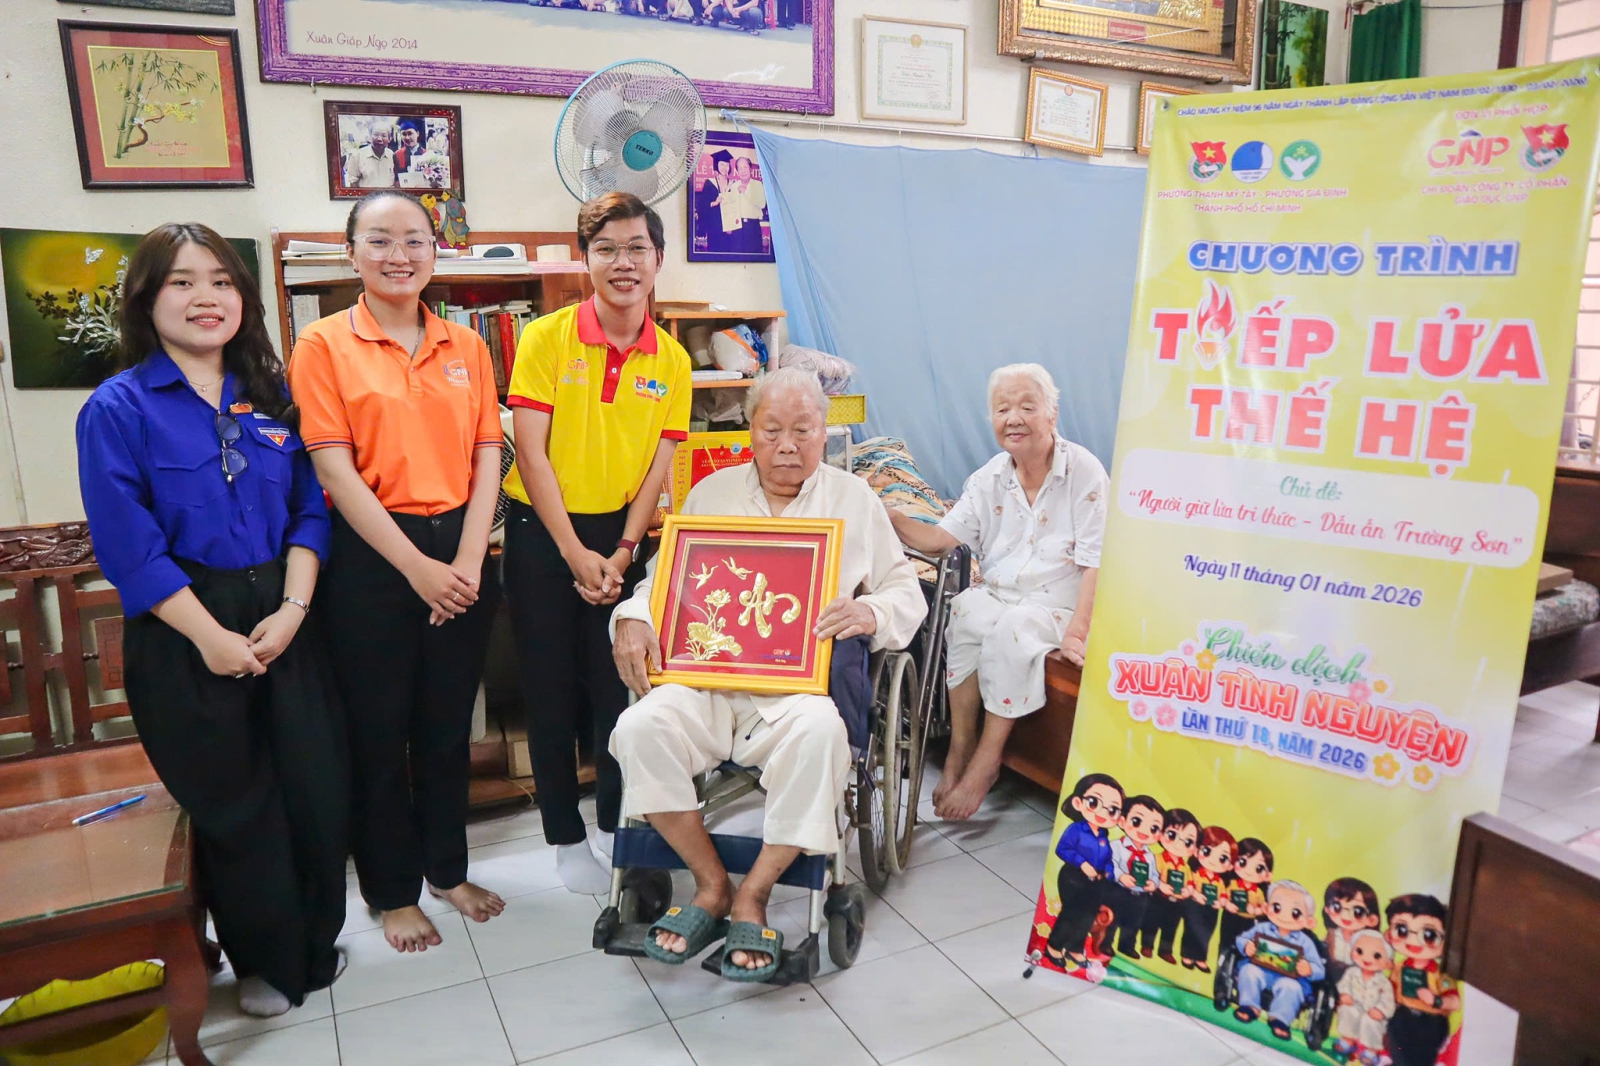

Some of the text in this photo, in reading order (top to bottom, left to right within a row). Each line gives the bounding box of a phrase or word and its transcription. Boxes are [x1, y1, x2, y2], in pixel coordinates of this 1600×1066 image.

[306, 30, 418, 51] Xuân Giáp Ngọ 2014
[1177, 106, 1196, 116] CHÀO
[1198, 105, 1220, 115] MỪNG
[1233, 102, 1252, 113] NIỆM
[1264, 102, 1281, 111] NĂM
[1419, 89, 1436, 100] VIỆT
[1439, 89, 1459, 98] NAM
[1428, 136, 1511, 169] GNP
[1157, 188, 1193, 199] PHƯỜNG
[1242, 188, 1258, 198] TÂY
[1265, 188, 1304, 198] PHƯỜNG
[1324, 188, 1348, 198] ĐỊNH
[1194, 201, 1301, 213] THÀNH PHỐ HỒ CHÍ MINH
[1187, 236, 1517, 274] CHƯƠNG TRÌNH
[1368, 306, 1542, 381] LỬA
[1189, 380, 1470, 476] THẾ HỆ
[1280, 475, 1342, 501] Chủ đề:
[1184, 501, 1210, 520] giữ
[1261, 506, 1297, 528] thức
[1319, 511, 1356, 537] Dấu
[1360, 514, 1386, 541] ấn
[1394, 520, 1465, 554] Trường
[1183, 554, 1424, 608] Ngày 11 tháng 01 năm 2026
[1204, 626, 1368, 686] Chiến dịch
[1114, 658, 1469, 766] XUÂN TÌNH NGUYỆN
[1181, 706, 1368, 772] LẦN THỨ 18, NĂM 2026
